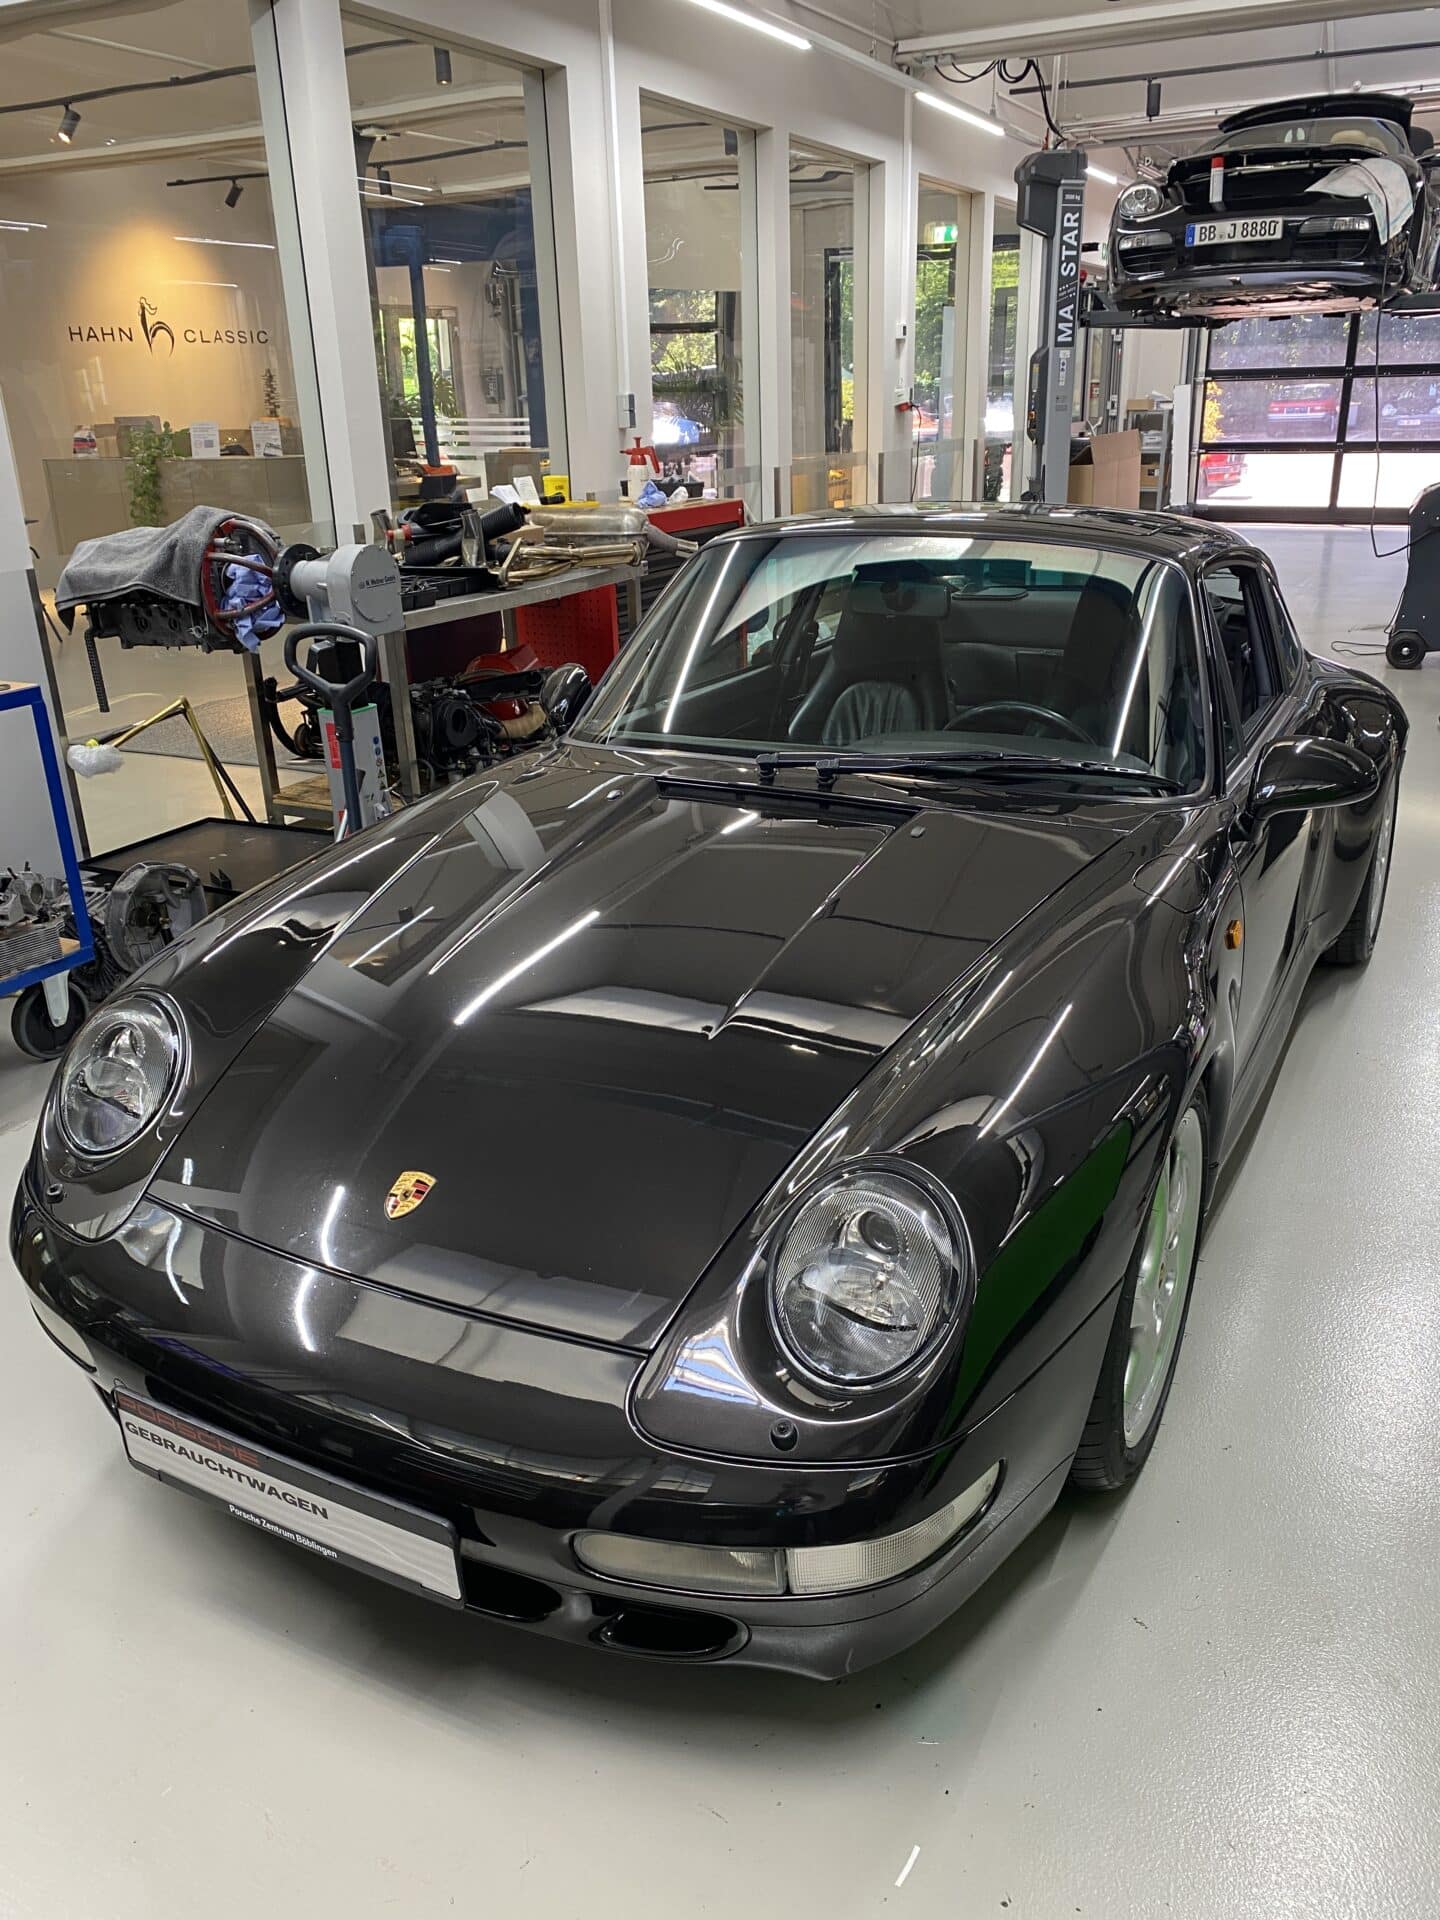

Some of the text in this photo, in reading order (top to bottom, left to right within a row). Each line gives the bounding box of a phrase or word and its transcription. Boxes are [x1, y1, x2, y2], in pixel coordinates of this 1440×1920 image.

[1060, 211, 1080, 277] STAR
[1199, 225, 1217, 242] BB
[1227, 223, 1237, 239] J
[1241, 220, 1279, 238] 8880
[68, 325, 270, 344] HAHN CLASSIC
[118, 1395, 261, 1469] PORSCHE
[125, 1420, 329, 1520] GEBRAUCHTWAGEN
[228, 1504, 338, 1558] Porsche Zentrum Böblingen
